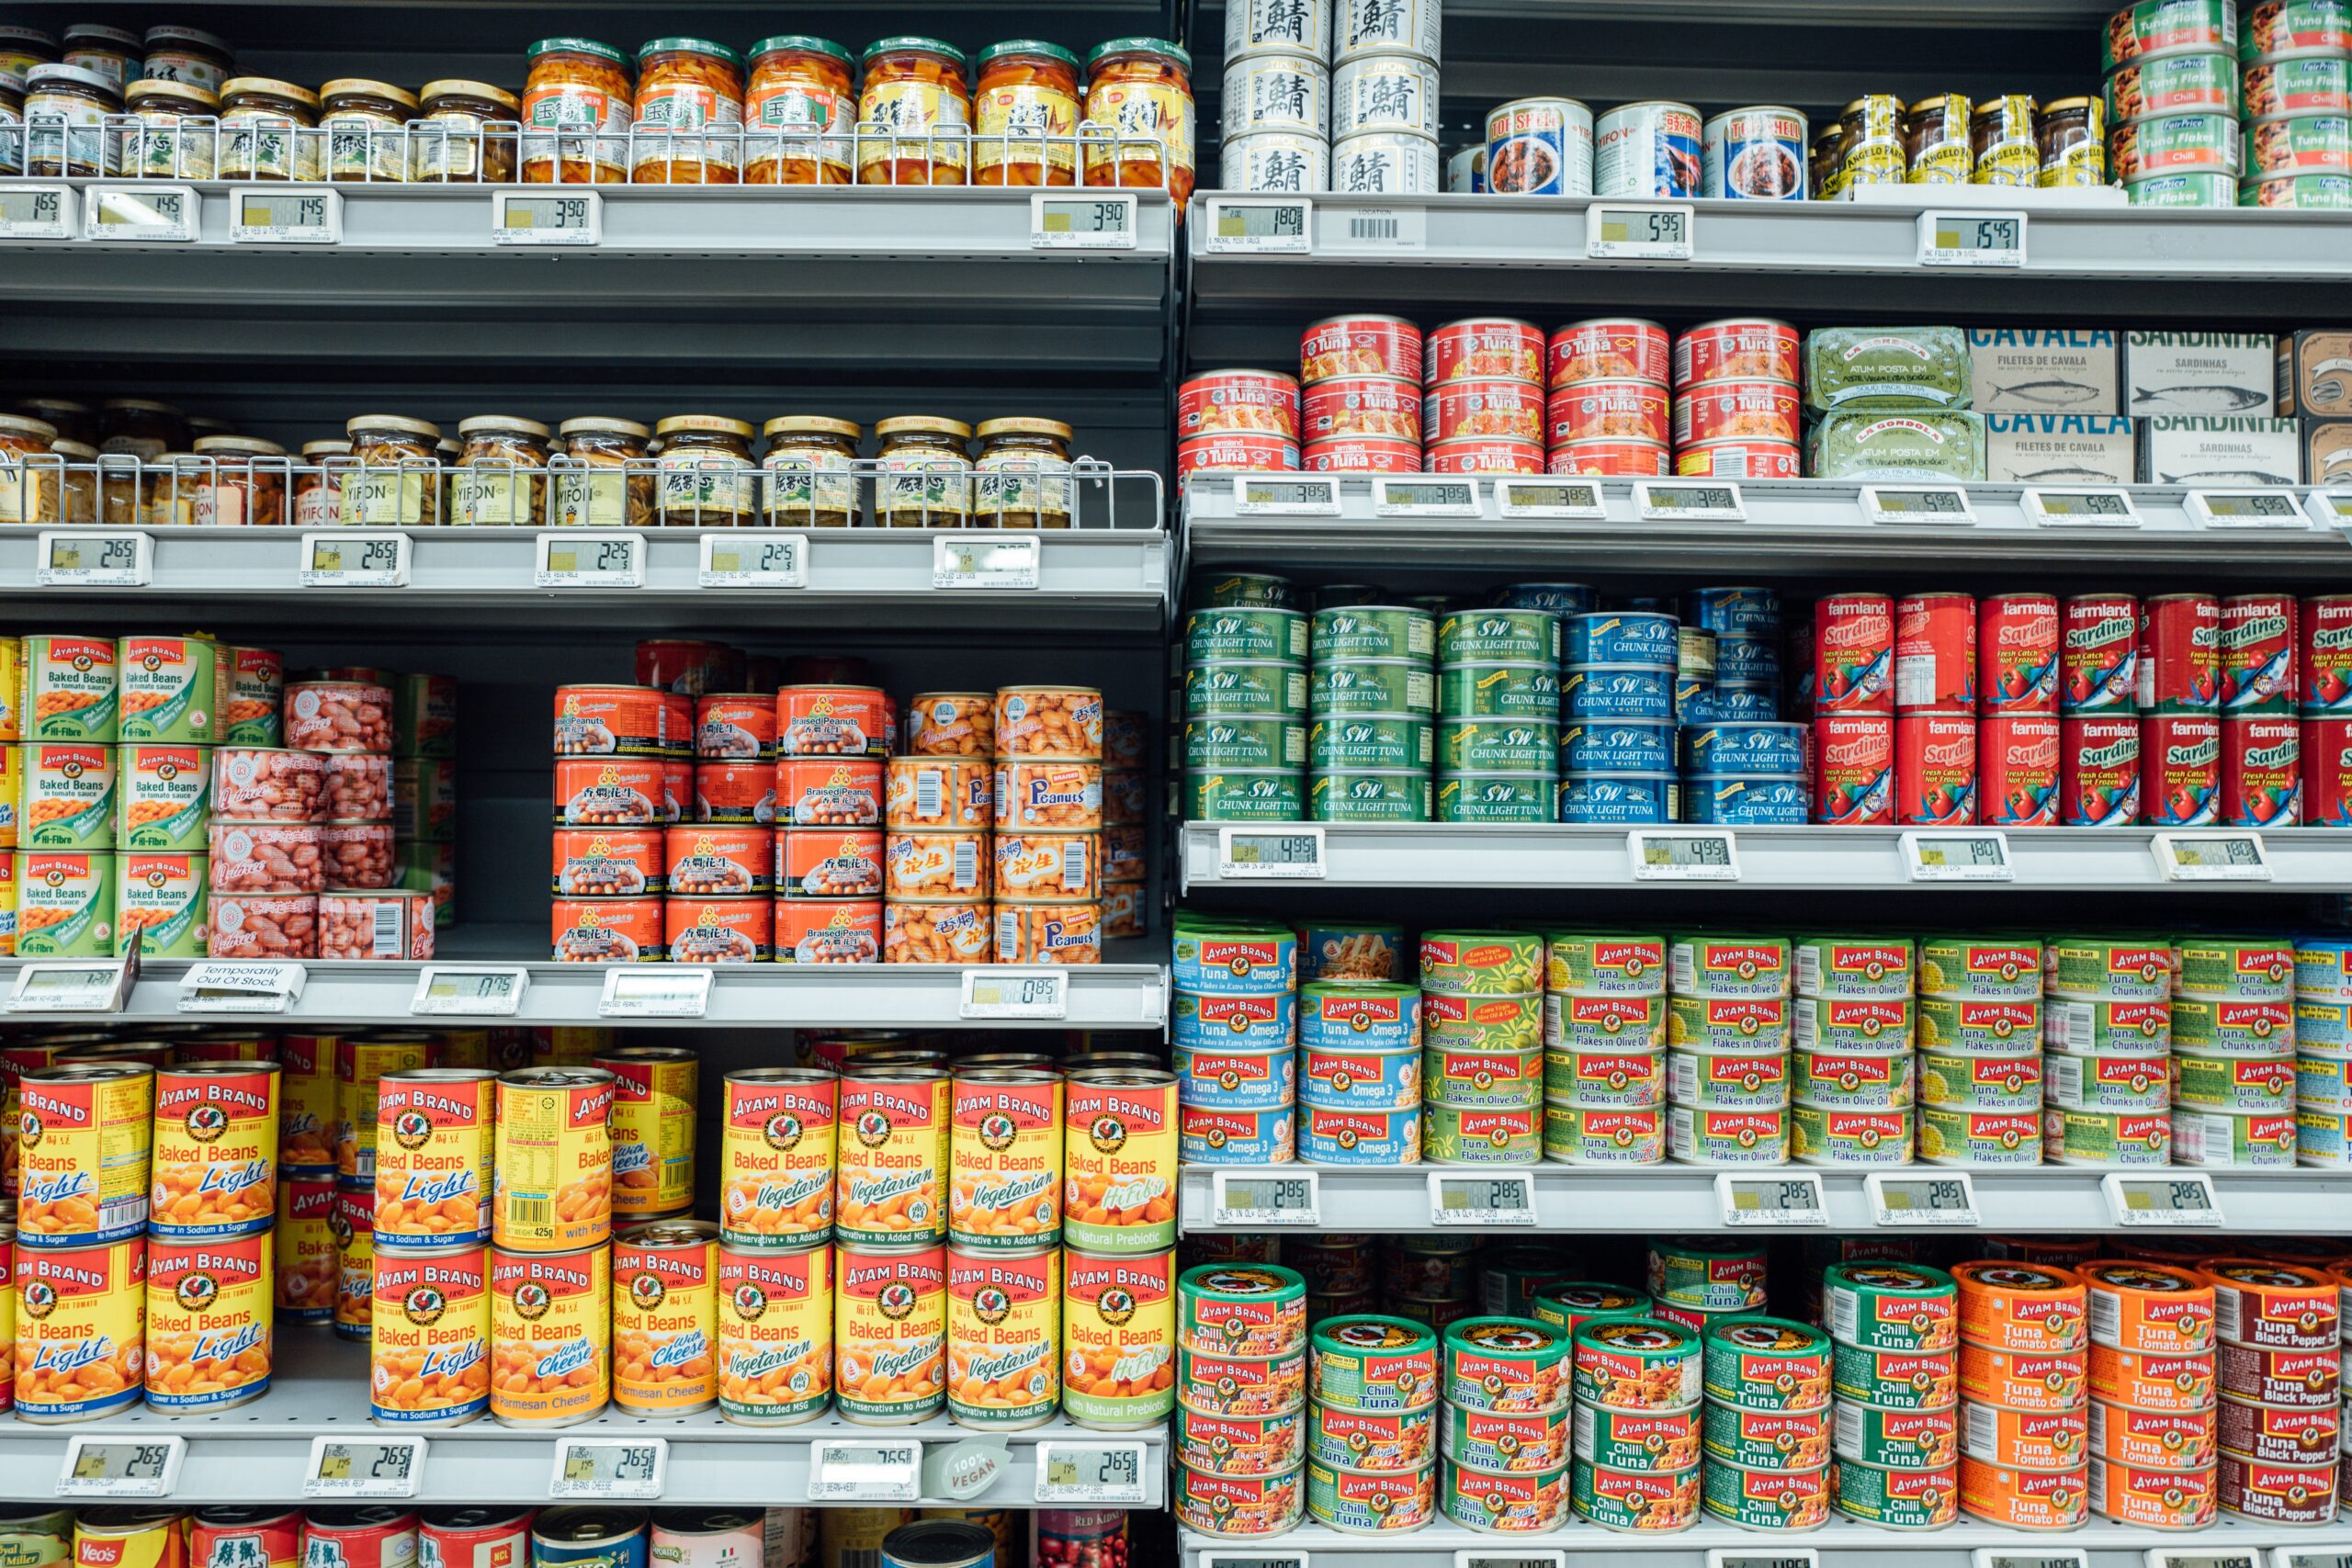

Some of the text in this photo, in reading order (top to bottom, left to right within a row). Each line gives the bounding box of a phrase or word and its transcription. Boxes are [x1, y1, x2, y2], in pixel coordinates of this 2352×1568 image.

[2165, 59, 2206, 71] FairPrice
[2148, 73, 2216, 89] Tuna Flakes
[2173, 92, 2196, 103] Chilli
[1847, 146, 1882, 169] ANGELO
[1317, 337, 1351, 353] Tuna
[1574, 338, 1611, 353] Tuna
[1997, 355, 2086, 366] FILETES DE CAVALA
[2176, 358, 2227, 368] SARDINHAS
[1878, 365, 1909, 373] POSTA
[1878, 421, 1940, 441] GONDOLA
[1828, 603, 1885, 616] farmland
[1825, 616, 1889, 645] Sardines
[1192, 637, 1272, 648] CHUNK LIGHT TUNA
[49, 671, 112, 684] Baked Beans
[1053, 772, 1079, 783] BRAISED
[840, 788, 872, 796] Peanuts
[1030, 780, 1084, 804] Peanuts
[1206, 945, 1272, 963] AYAM BRAND
[205, 964, 282, 976] Temporarily
[1200, 967, 1285, 980] Tuna Omega 3
[197, 976, 277, 987] Out Of Stock
[1200, 982, 1218, 990] Flakes
[1227, 982, 1243, 990] Extra
[1244, 981, 1261, 992] Virgin
[1262, 981, 1276, 990] Olive
[1569, 1023, 1595, 1034] Tuna
[159, 1085, 266, 1111] AYAM BRAND
[232, 1109, 248, 1117] 1892
[159, 1145, 258, 1164] Baked Beans
[198, 1162, 271, 1194] Light
[755, 1167, 833, 1205] Vegetarian
[158, 1225, 176, 1235] Lower
[187, 1224, 216, 1233] Sodium
[220, 1224, 225, 1232] &
[228, 1221, 248, 1233] Sugar
[534, 1225, 553, 1238] 425g
[726, 1231, 831, 1246] No Preservative No Added MSG
[1078, 1231, 1159, 1246] Natural Prebiotic
[1197, 1325, 1222, 1340] Chilli
[2003, 1324, 2042, 1338] Tuna
[2254, 1318, 2296, 1335] Tuna
[560, 1338, 588, 1357] With
[1193, 1336, 1227, 1352] Tuna
[2004, 1337, 2073, 1349] Tomato Chilli
[2256, 1332, 2326, 1348] Black Pepper
[537, 1348, 592, 1377] Cheese
[500, 1392, 591, 1410] Parmesan Cheese
[954, 1452, 986, 1472] 100%
[952, 1459, 995, 1487] VEGAN
[1075, 1516, 1092, 1528] RED
[81, 1543, 116, 1562] Yeo's
